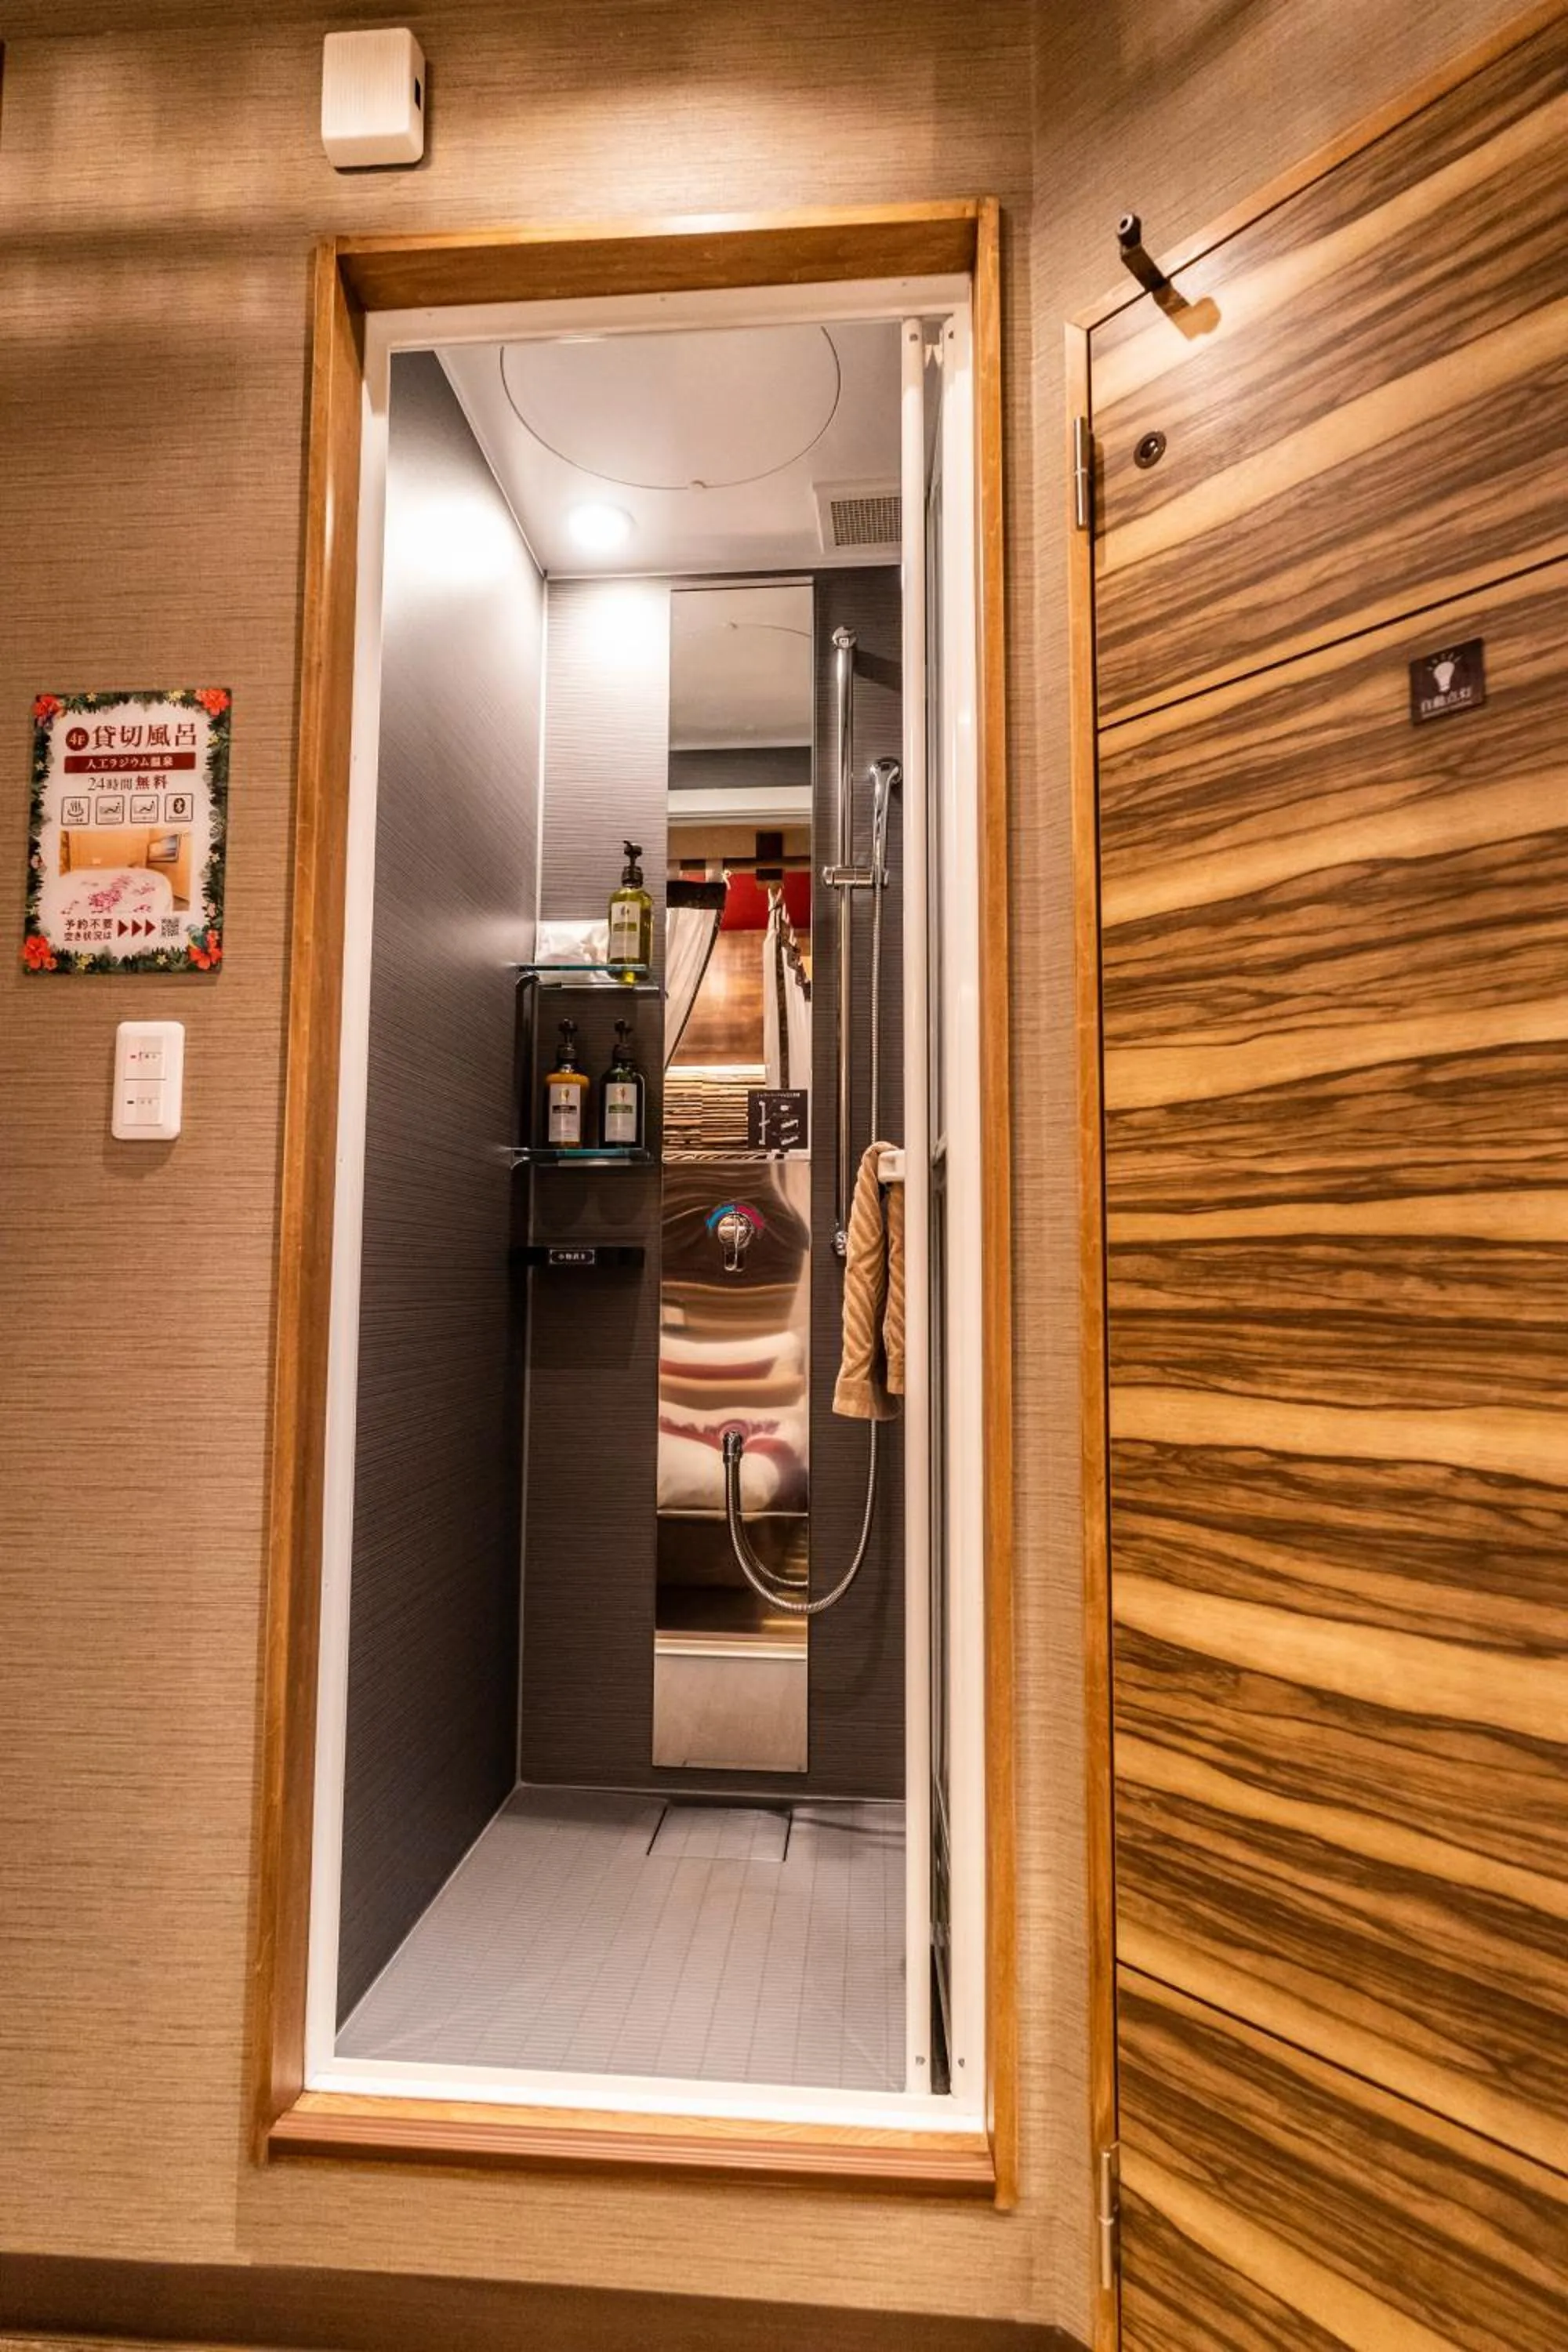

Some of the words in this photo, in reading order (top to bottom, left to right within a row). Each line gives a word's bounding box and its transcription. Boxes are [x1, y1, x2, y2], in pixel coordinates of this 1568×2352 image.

[68, 732, 85, 746] 4F
[92, 723, 197, 750] 貸切風呂
[85, 756, 174, 770] 人工ラジウム温泉
[87, 774, 169, 791] 24時間無料
[64, 918, 113, 931] 予約不要
[64, 931, 112, 942] 空き状況は
